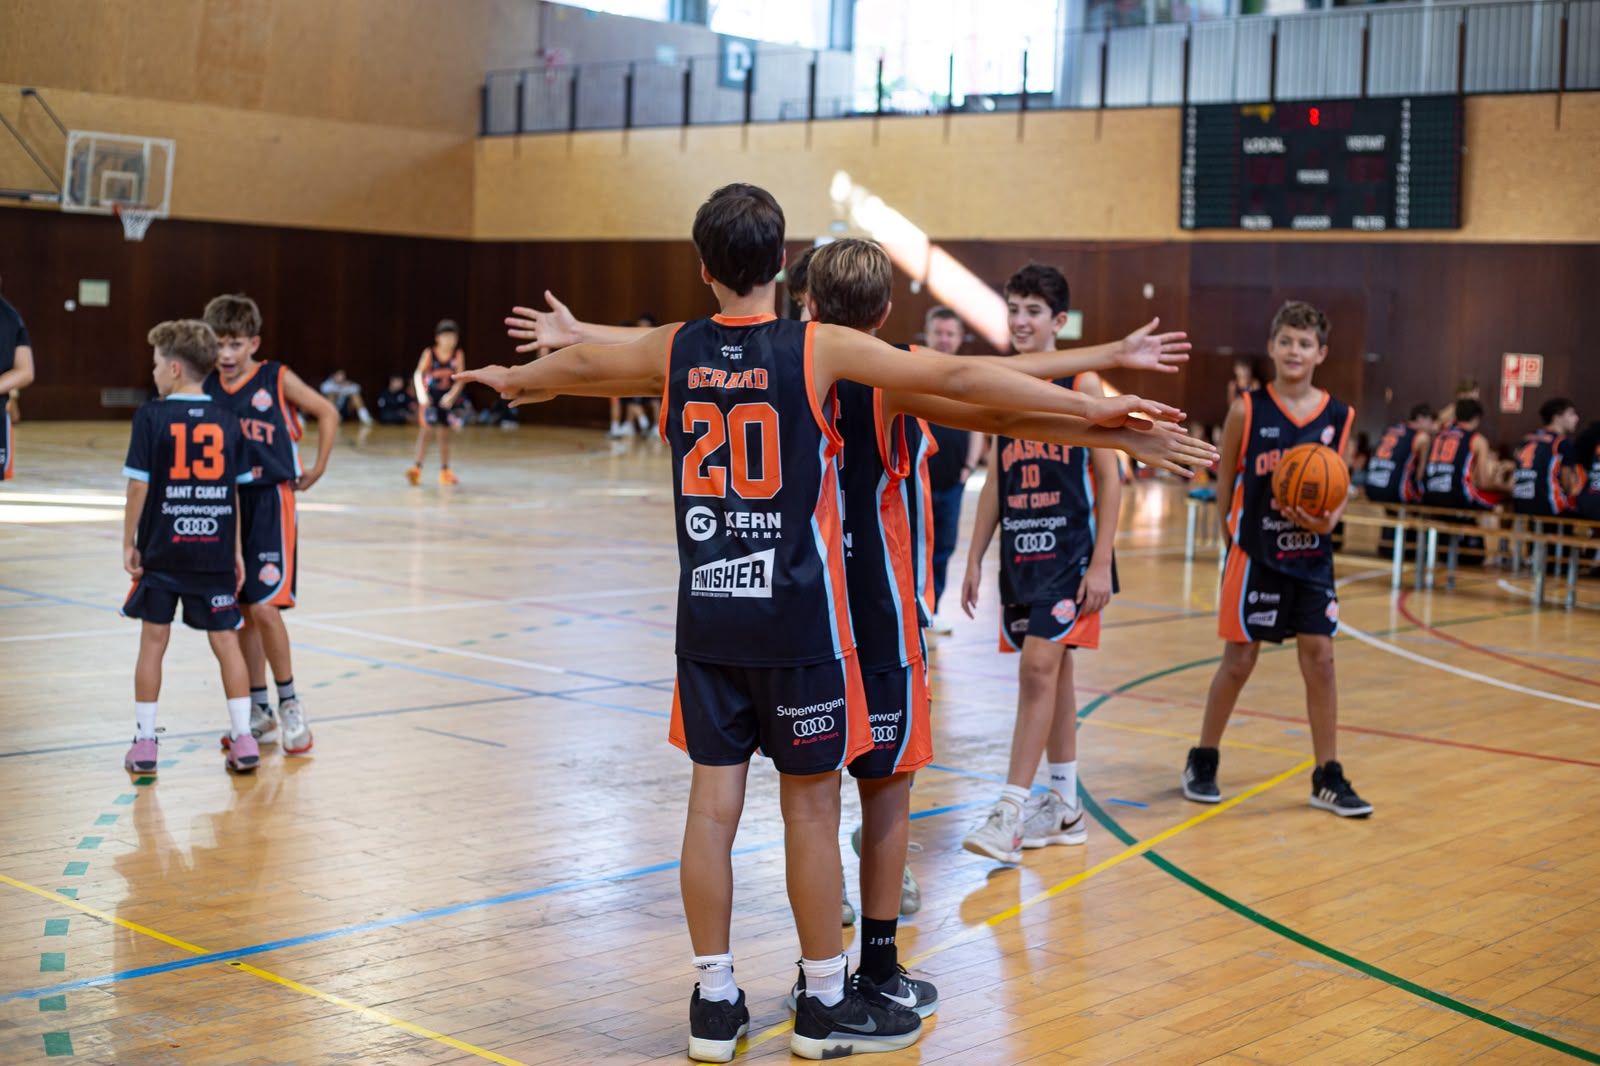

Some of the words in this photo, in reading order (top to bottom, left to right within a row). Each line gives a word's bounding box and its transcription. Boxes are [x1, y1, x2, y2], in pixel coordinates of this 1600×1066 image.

[240, 418, 275, 445] KET
[169, 423, 225, 480] 13
[682, 401, 782, 499] 20
[1021, 464, 1040, 489] 10
[166, 486, 192, 499] SANT
[195, 486, 228, 499] CUGAT
[162, 502, 232, 517] Superwagen
[724, 511, 781, 529] KERN
[694, 559, 766, 589] FNISHER
[776, 698, 844, 718] Superwagen
[869, 709, 902, 723] erwag
